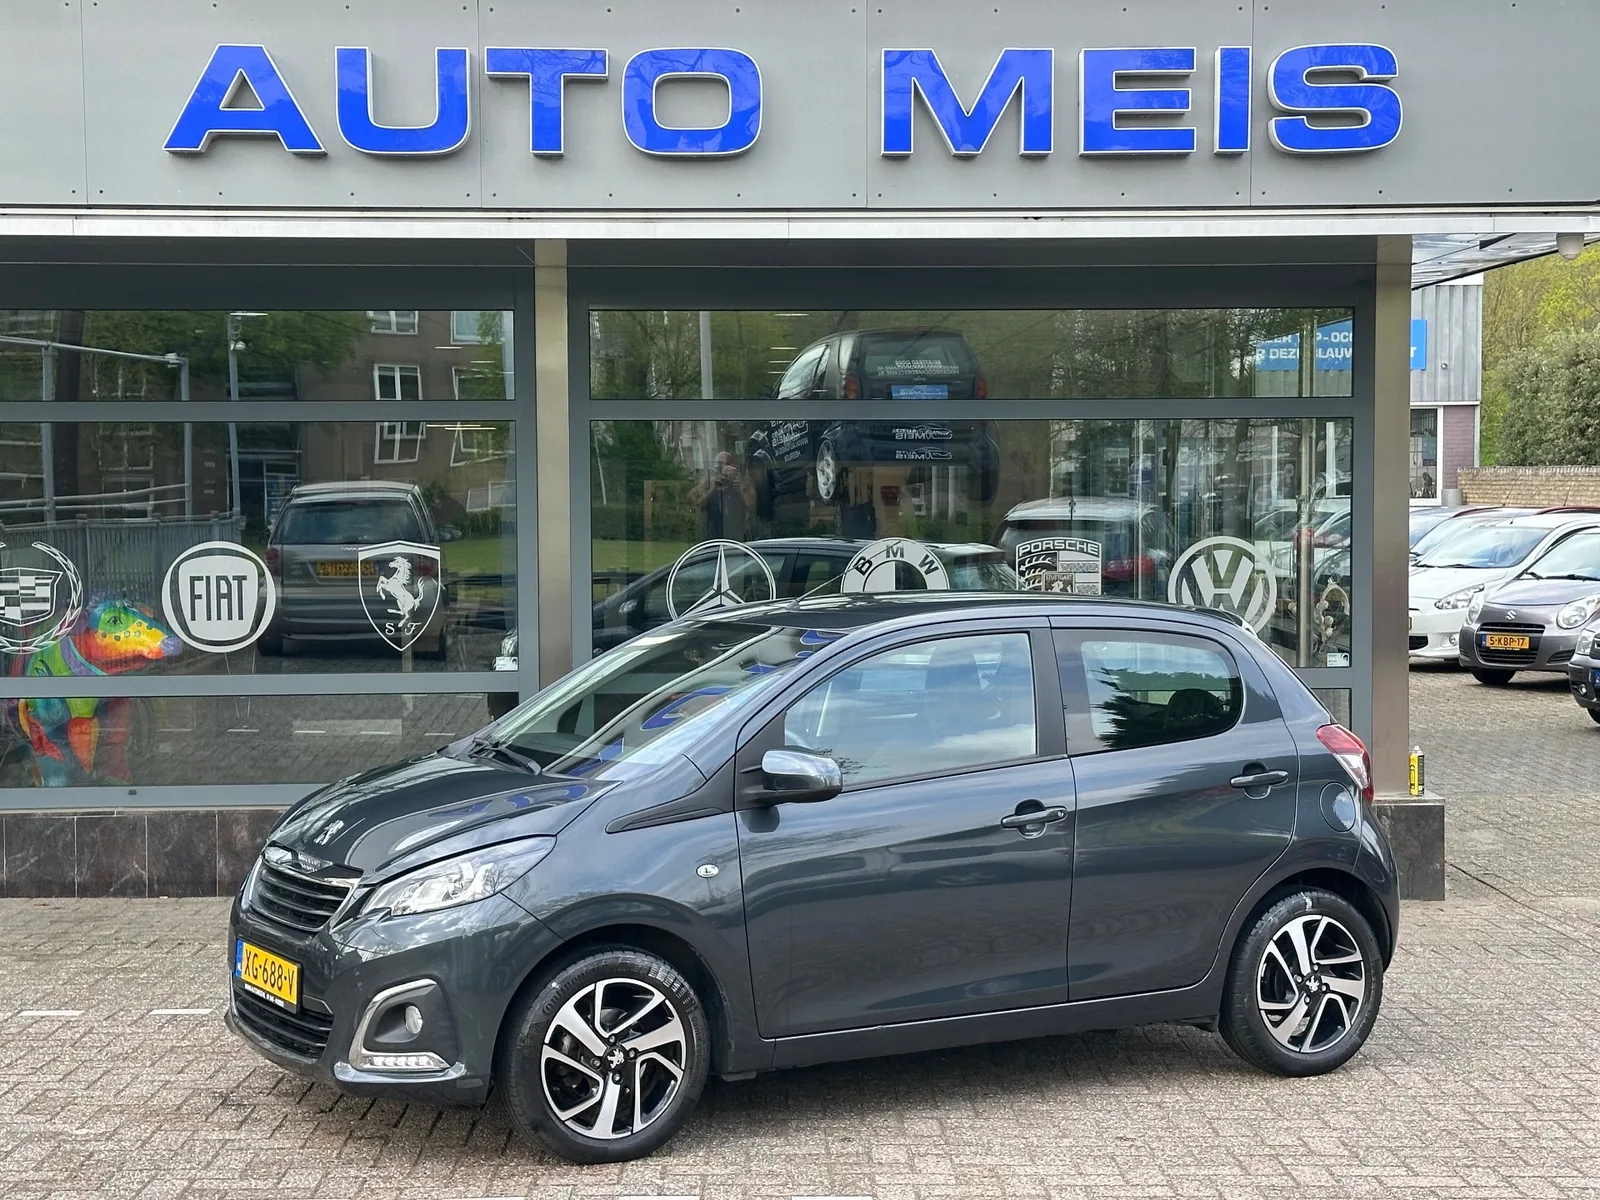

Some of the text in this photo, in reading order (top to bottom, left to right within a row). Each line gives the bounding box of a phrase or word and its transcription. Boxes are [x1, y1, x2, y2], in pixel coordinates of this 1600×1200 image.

[162, 42, 1403, 157] AUTO MEIS
[1019, 540, 1099, 557] PORSCHE
[189, 575, 248, 621] FIAT
[1490, 637, 1525, 647] 5-KBP-17
[244, 949, 295, 997] XG-688-V
